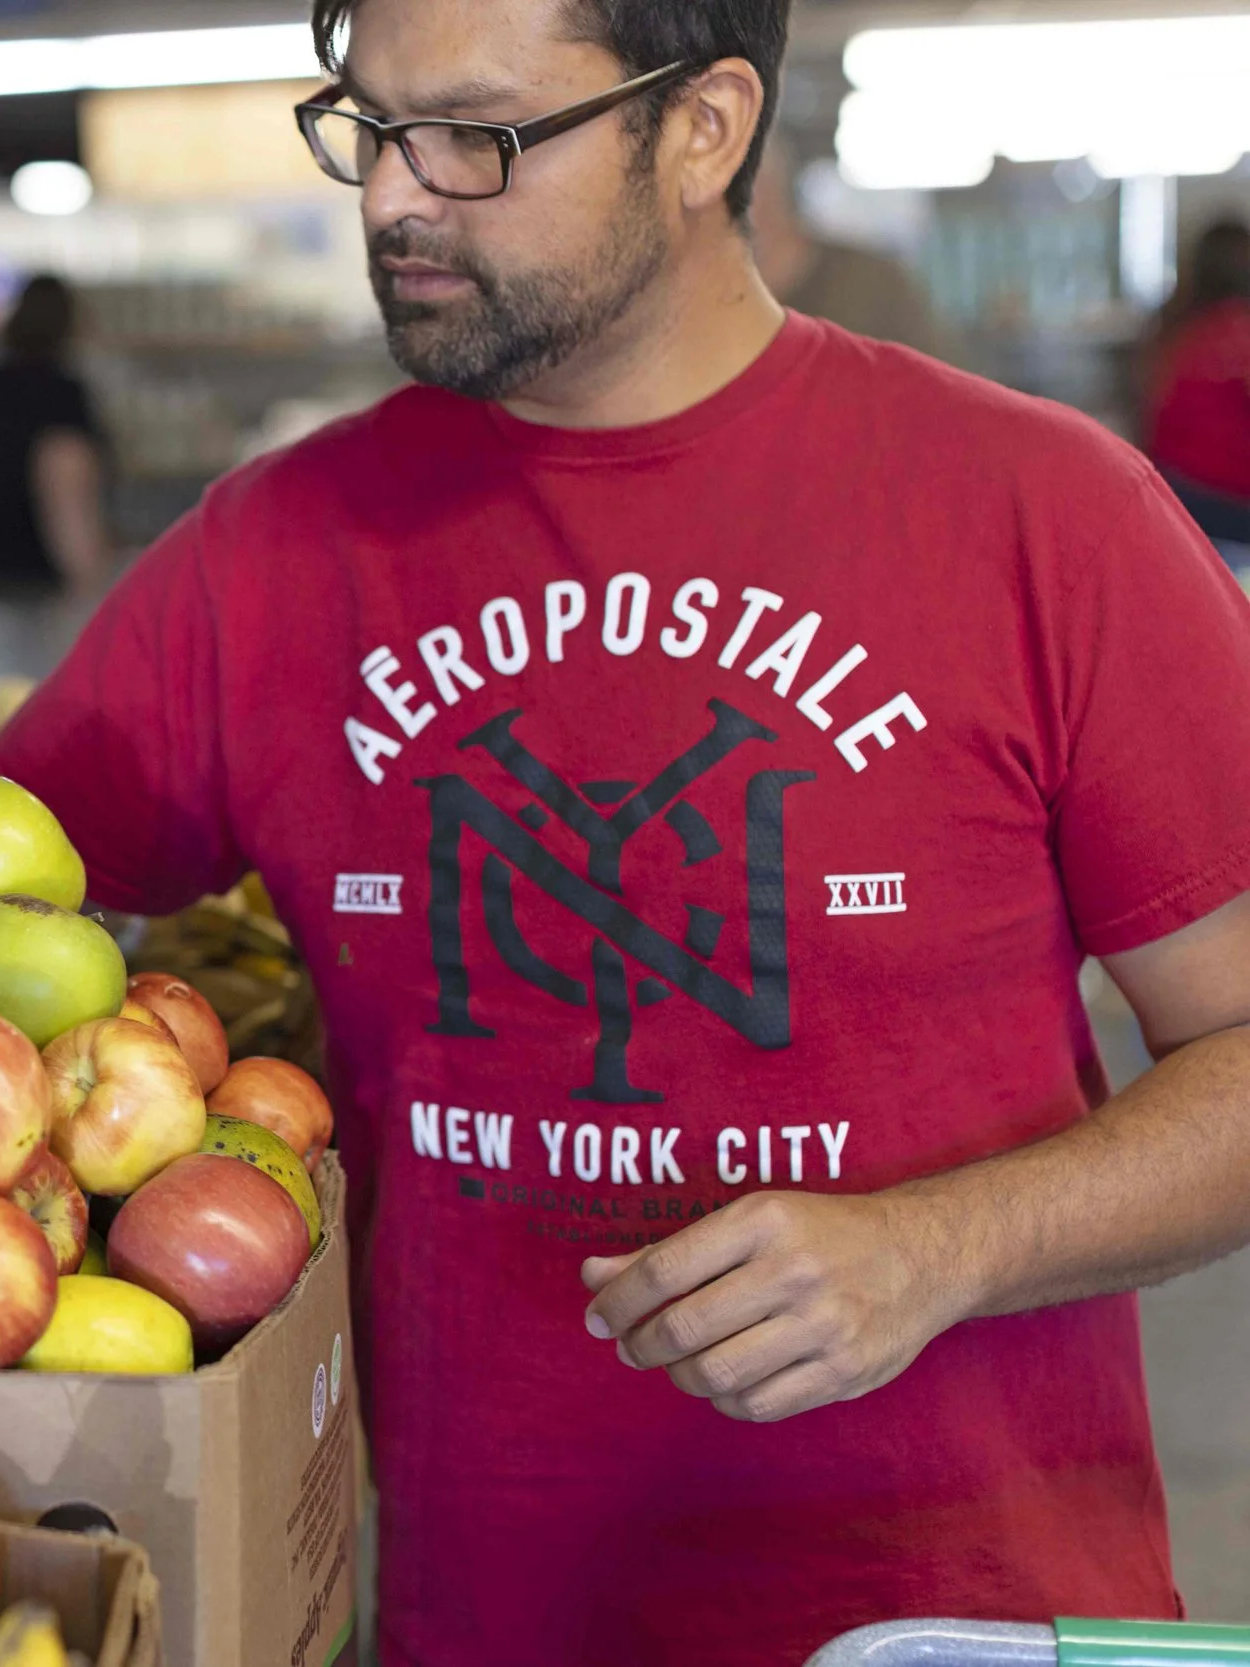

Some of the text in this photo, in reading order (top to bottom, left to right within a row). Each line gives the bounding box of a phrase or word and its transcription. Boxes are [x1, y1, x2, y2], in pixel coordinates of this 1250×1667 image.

[824, 874, 906, 913] XXVII
[409, 1100, 851, 1185] NEW YORK CITY
[490, 1181, 629, 1219] ORIGINAL
